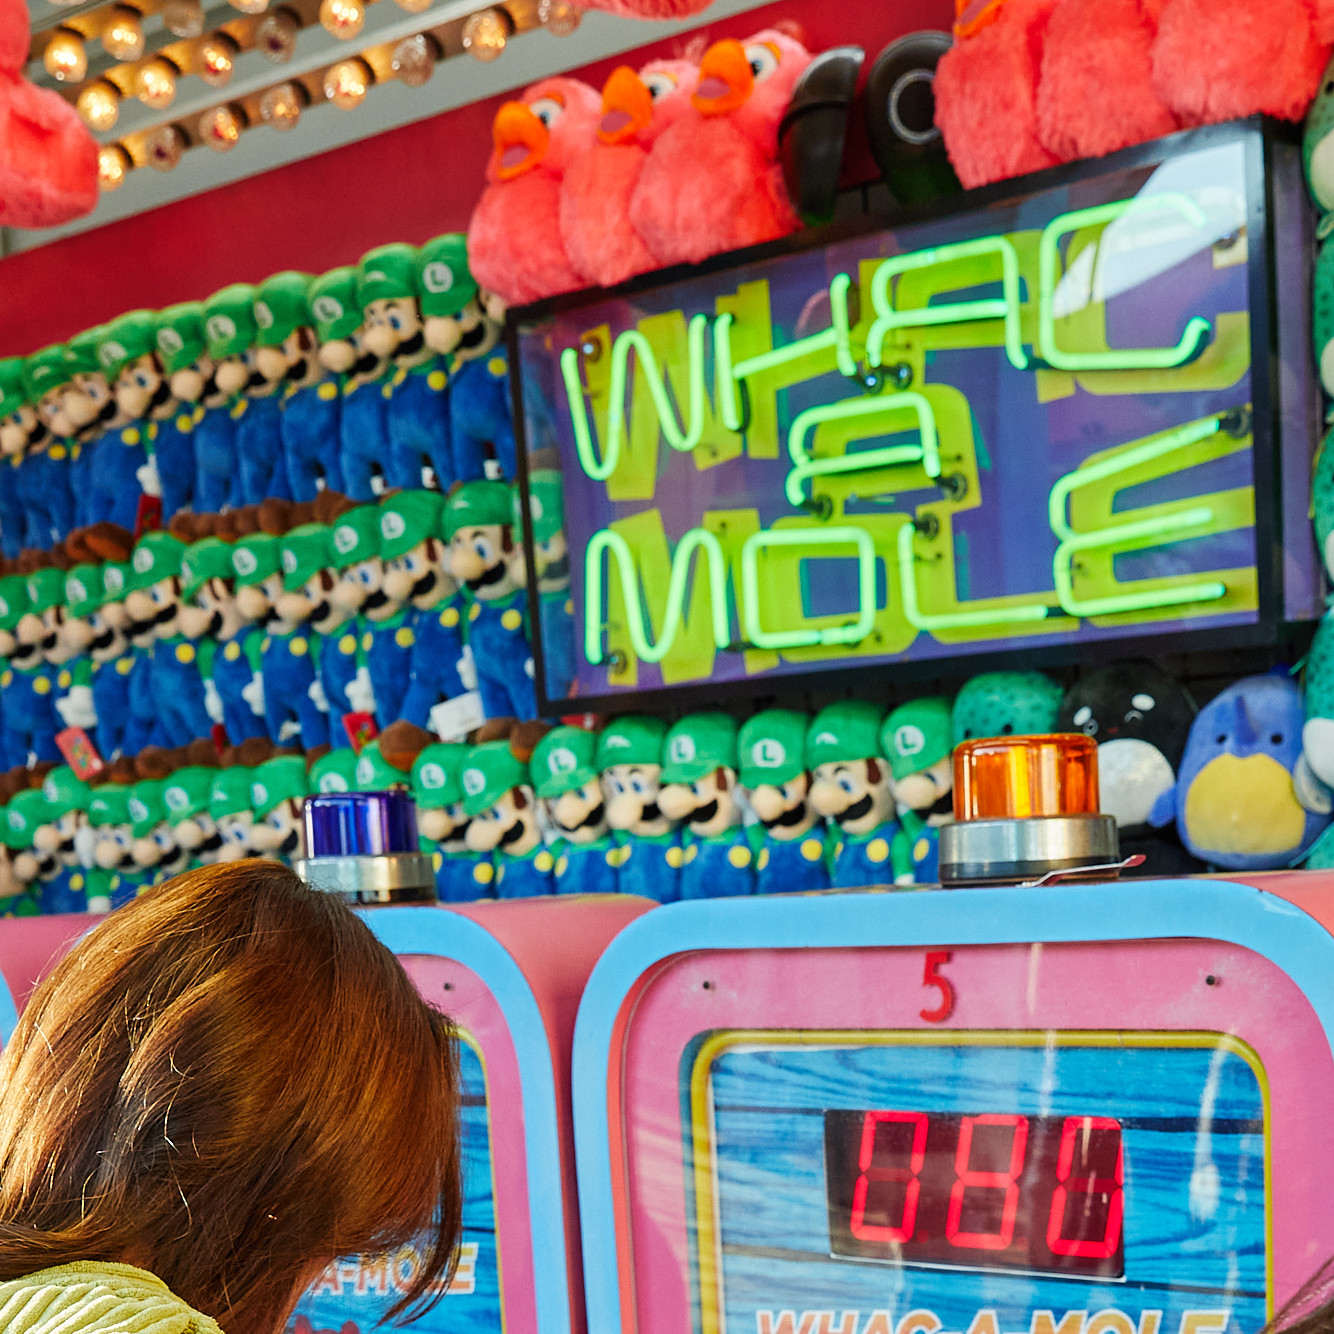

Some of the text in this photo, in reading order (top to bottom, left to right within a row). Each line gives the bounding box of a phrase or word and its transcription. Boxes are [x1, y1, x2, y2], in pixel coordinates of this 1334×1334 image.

[560, 192, 1213, 481] WHAC
[584, 416, 1229, 666] MOLE
[920, 950, 955, 1024] 5
